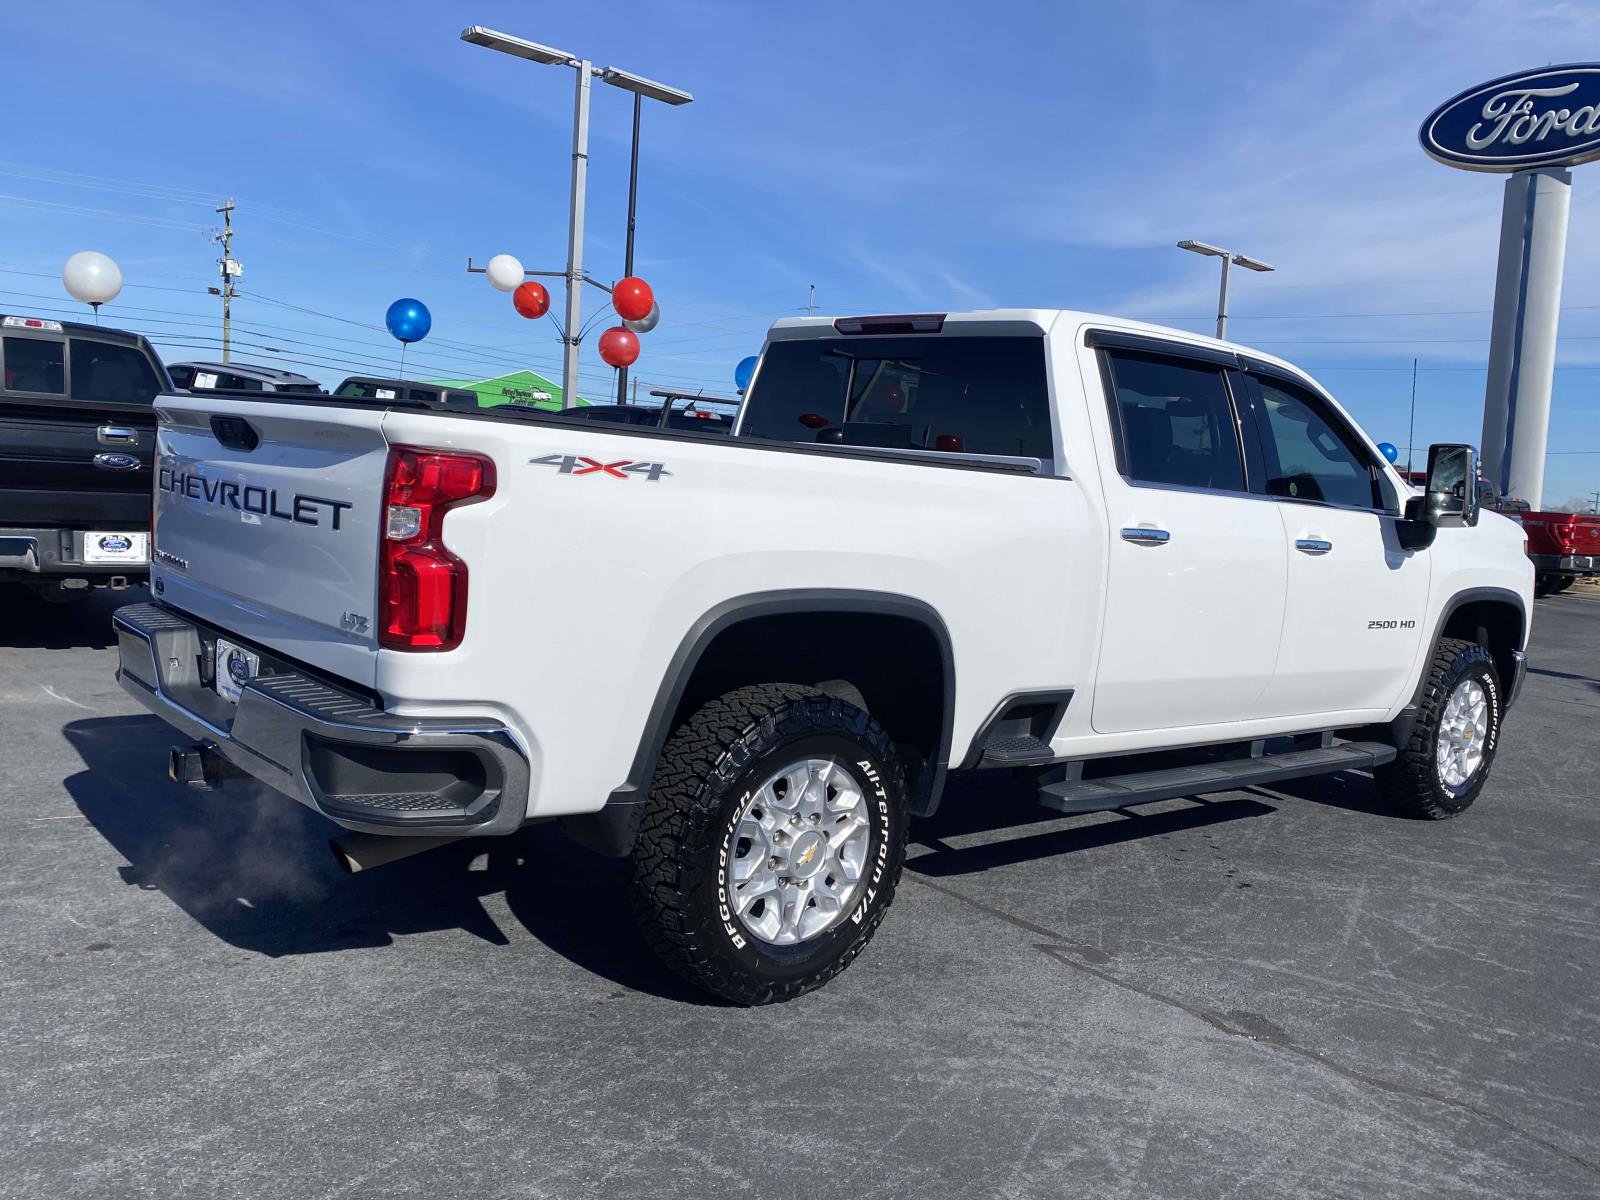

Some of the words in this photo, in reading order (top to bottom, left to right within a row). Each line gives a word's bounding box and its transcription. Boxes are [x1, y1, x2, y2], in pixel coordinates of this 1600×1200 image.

[1466, 82, 1600, 150] Ford
[159, 469, 353, 531] CHEVROLET
[1368, 620, 1397, 630] 2500
[1399, 620, 1416, 629] HD
[1482, 673, 1499, 750] BFGoodrich
[856, 759, 890, 883] All-Terrain
[717, 790, 751, 950] BFGoodrich
[851, 887, 877, 925] T/A
